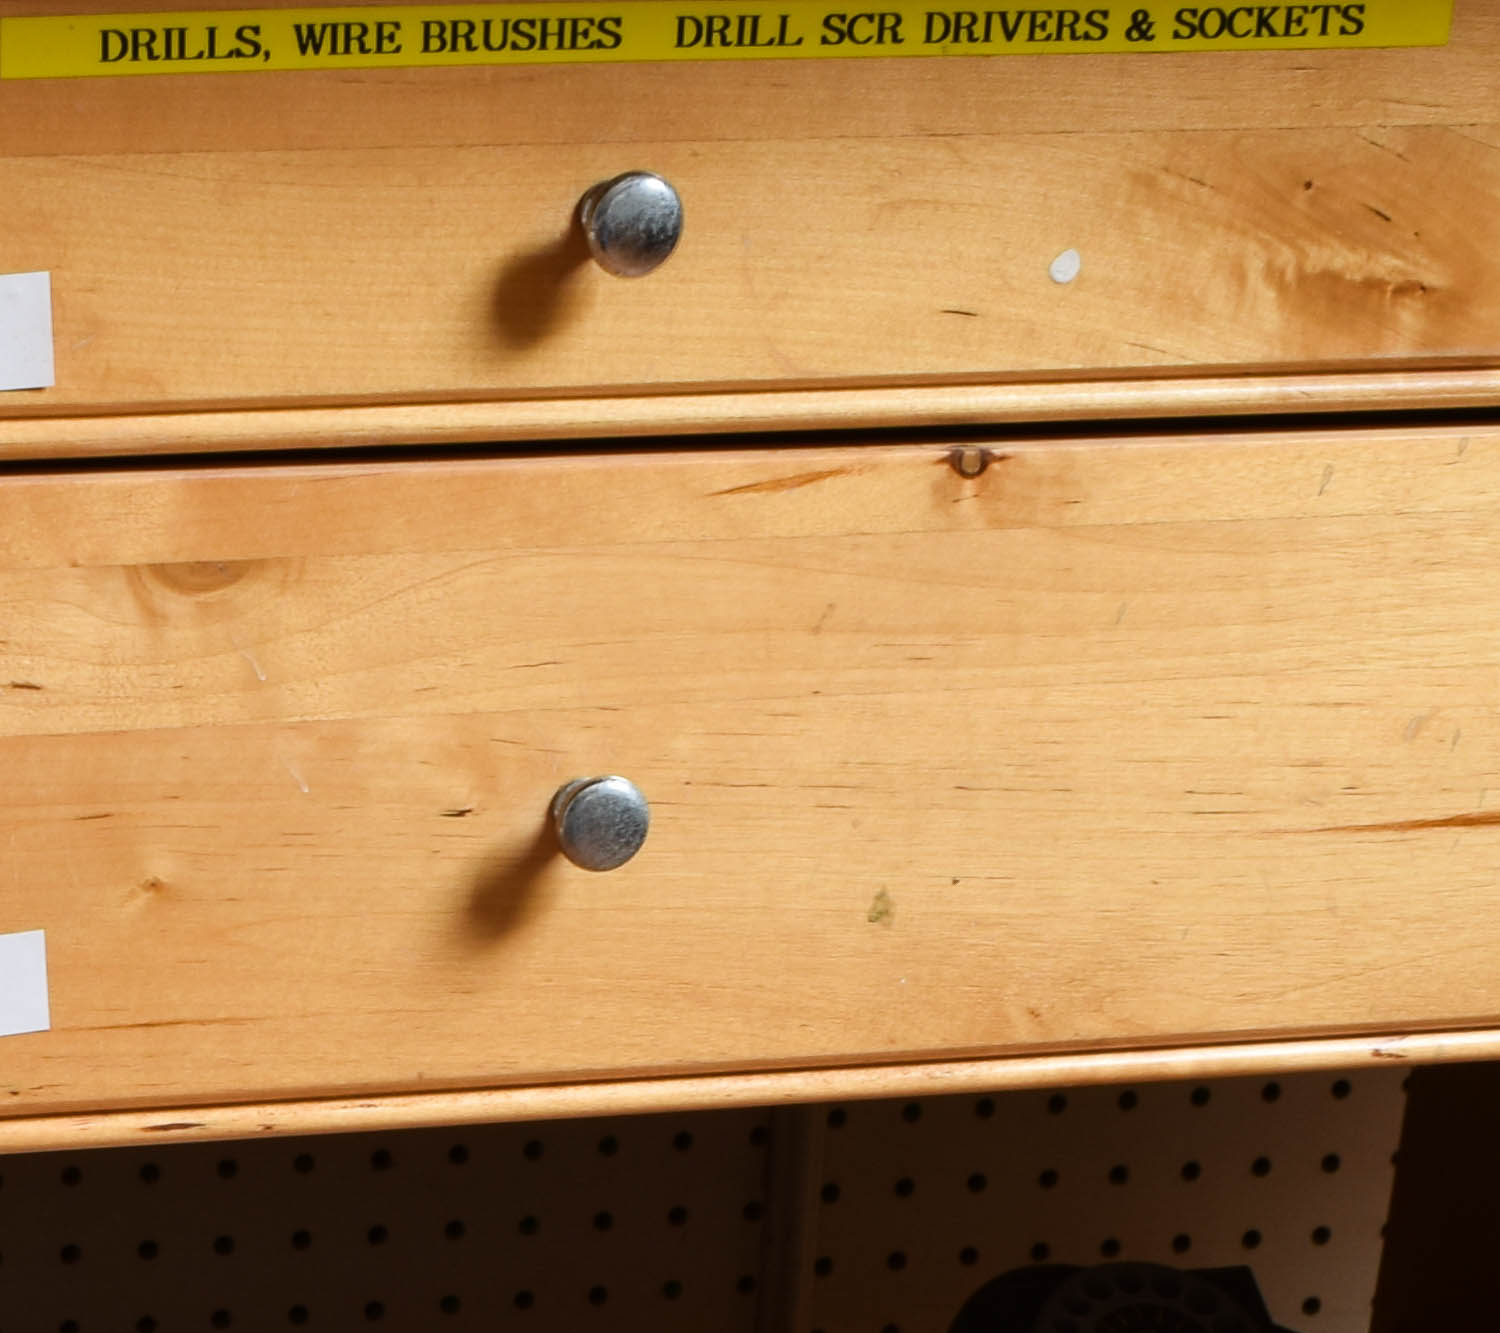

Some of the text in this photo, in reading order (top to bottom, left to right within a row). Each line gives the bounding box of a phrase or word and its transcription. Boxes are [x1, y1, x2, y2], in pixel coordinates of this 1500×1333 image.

[101, 4, 1365, 62] DRILLS, WIRE BRUSHES DRILL SCR DRIVERS & SOCKETS
